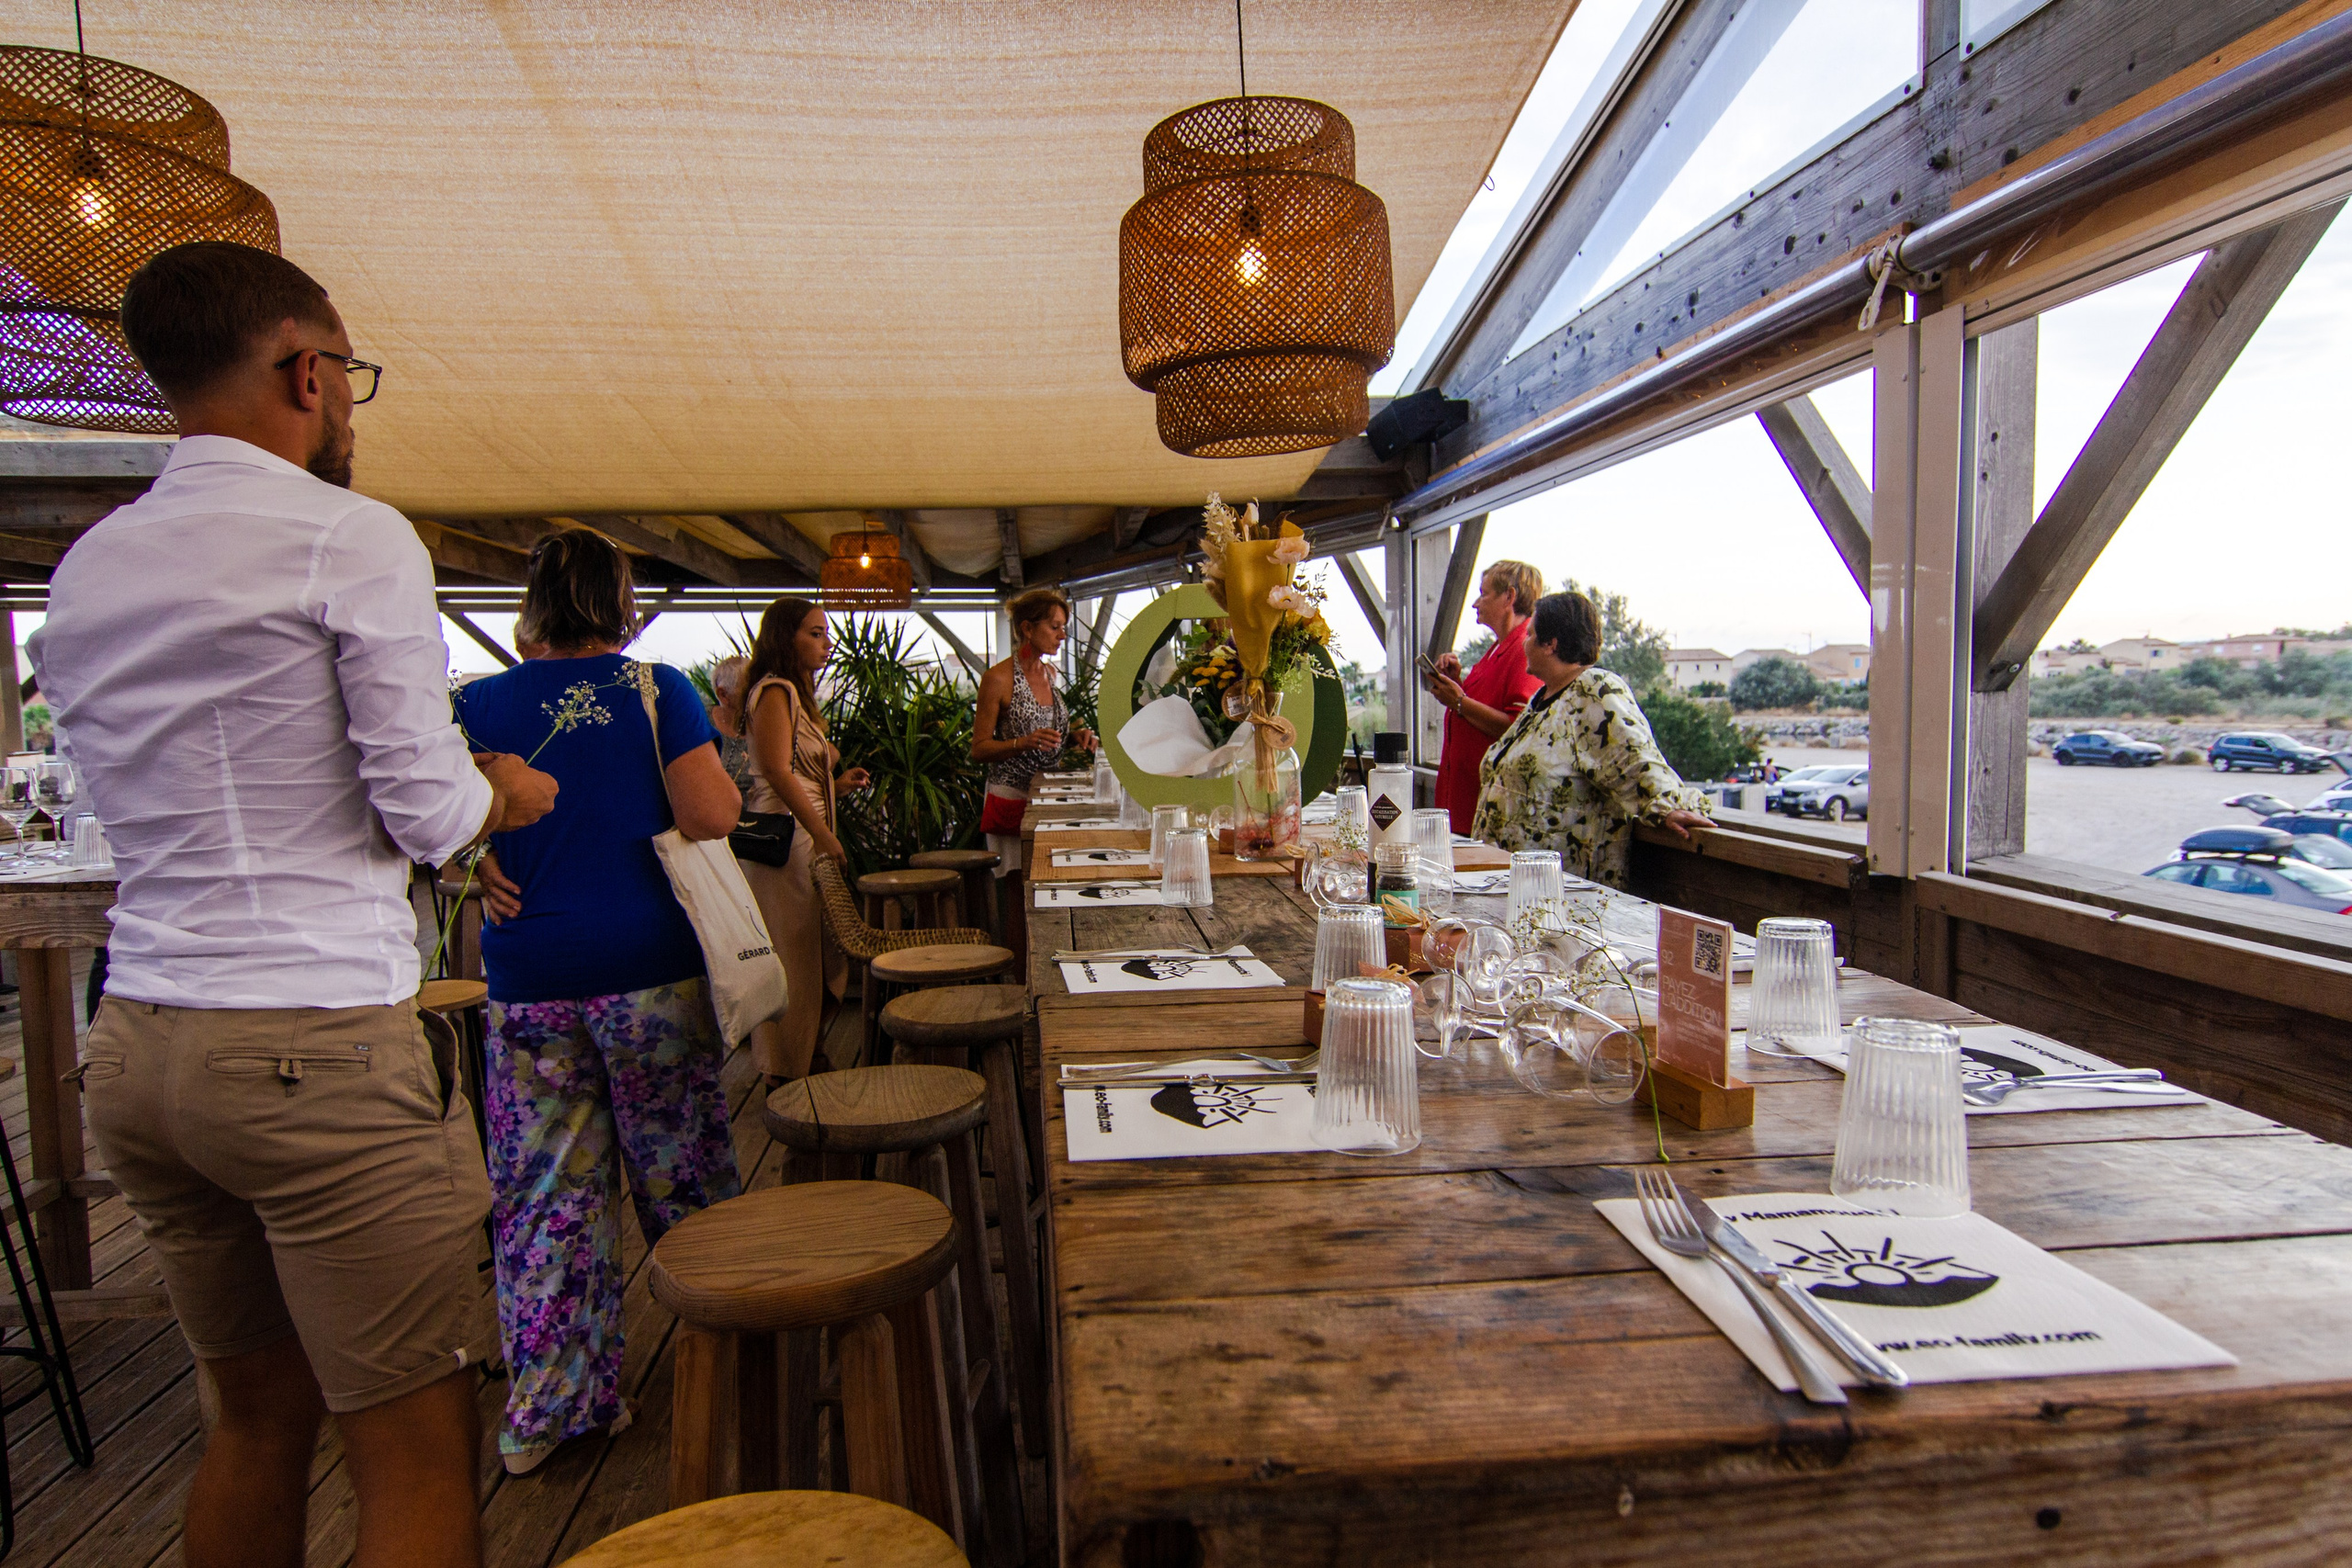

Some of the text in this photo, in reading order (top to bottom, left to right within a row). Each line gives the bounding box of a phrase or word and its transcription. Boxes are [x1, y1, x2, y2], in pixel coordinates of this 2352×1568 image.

[738, 947, 770, 961] GÉRARD
[1661, 949, 1674, 965] 92
[1662, 976, 1698, 999] PAYEZ
